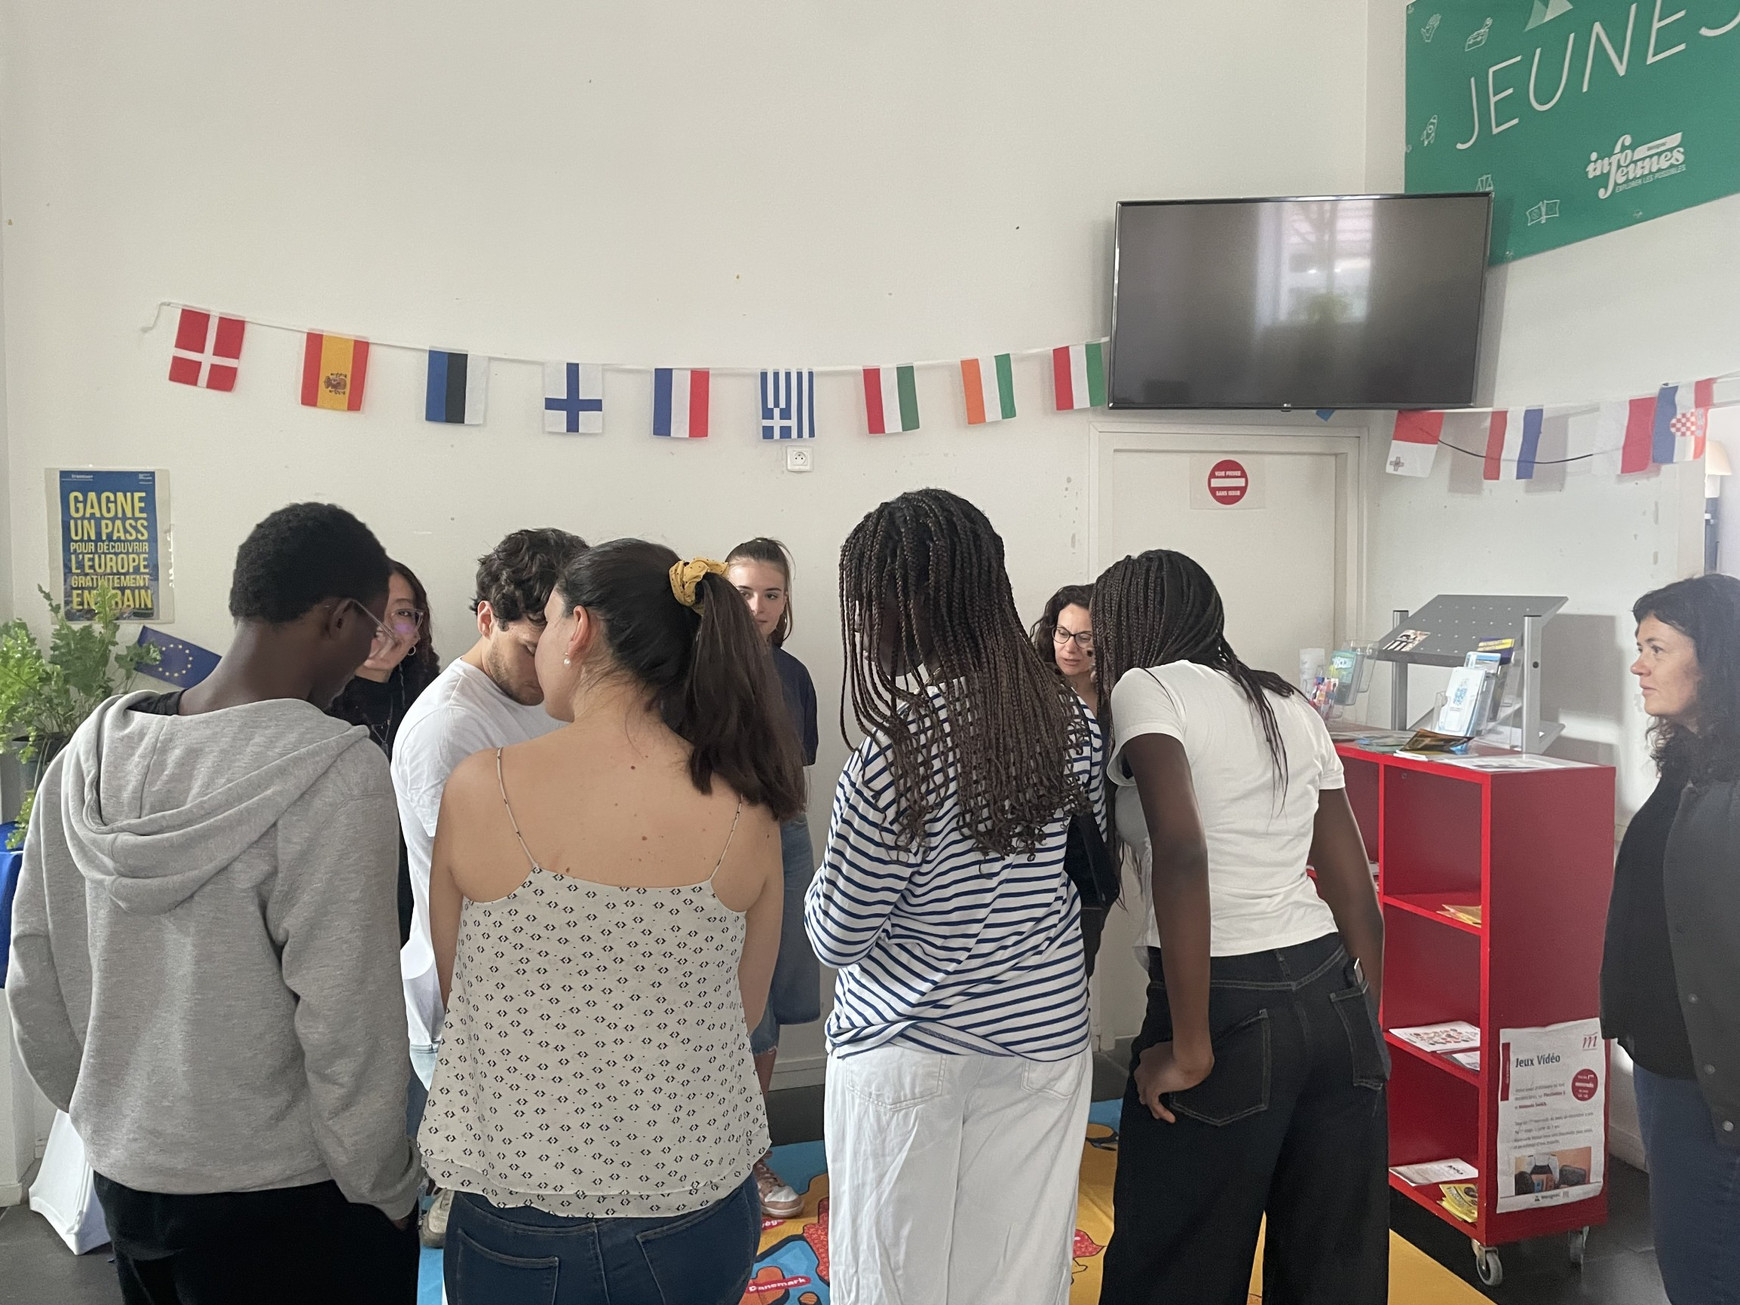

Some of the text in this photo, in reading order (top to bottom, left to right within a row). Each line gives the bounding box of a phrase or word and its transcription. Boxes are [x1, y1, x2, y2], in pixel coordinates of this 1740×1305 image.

[1586, 134, 1632, 180] info
[69, 491, 147, 518] GAGNE
[69, 519, 148, 540] UN PASS
[70, 540, 149, 553] POUR DÉCOUVRIR
[71, 554, 150, 574] L'EUROPE
[72, 589, 152, 610] EN RAIN
[1515, 1052, 1561, 1068] Jeux Vidéo
[748, 1277, 807, 1292] Danemark
